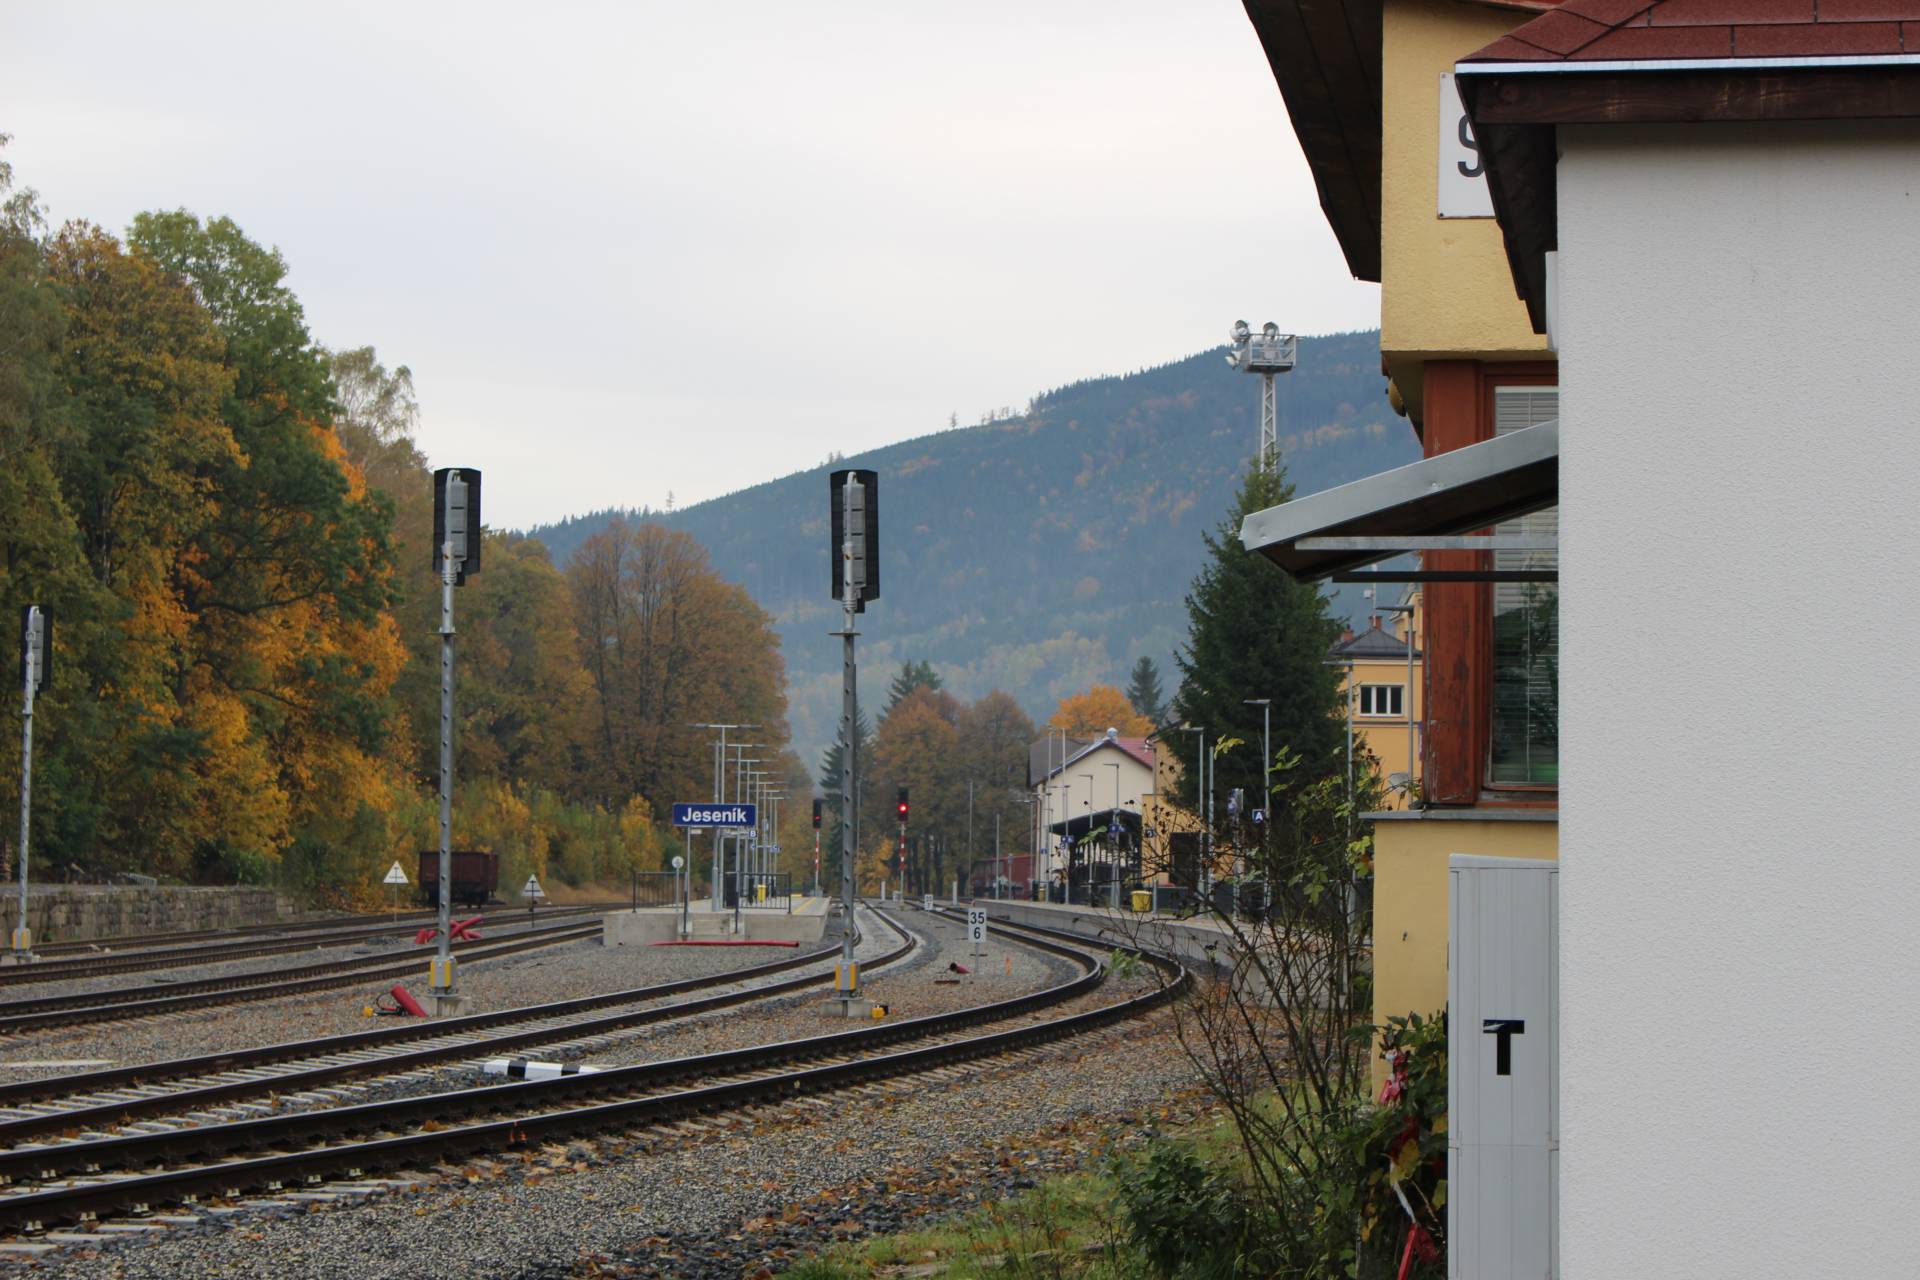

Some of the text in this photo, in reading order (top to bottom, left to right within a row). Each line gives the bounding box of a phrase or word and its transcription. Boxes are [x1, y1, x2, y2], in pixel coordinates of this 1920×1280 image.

[682, 807, 747, 822] Jeseník
[1255, 811, 1263, 820] A
[970, 912, 985, 924] 35
[973, 927, 981, 939] 6
[1483, 1019, 1525, 1075] T
